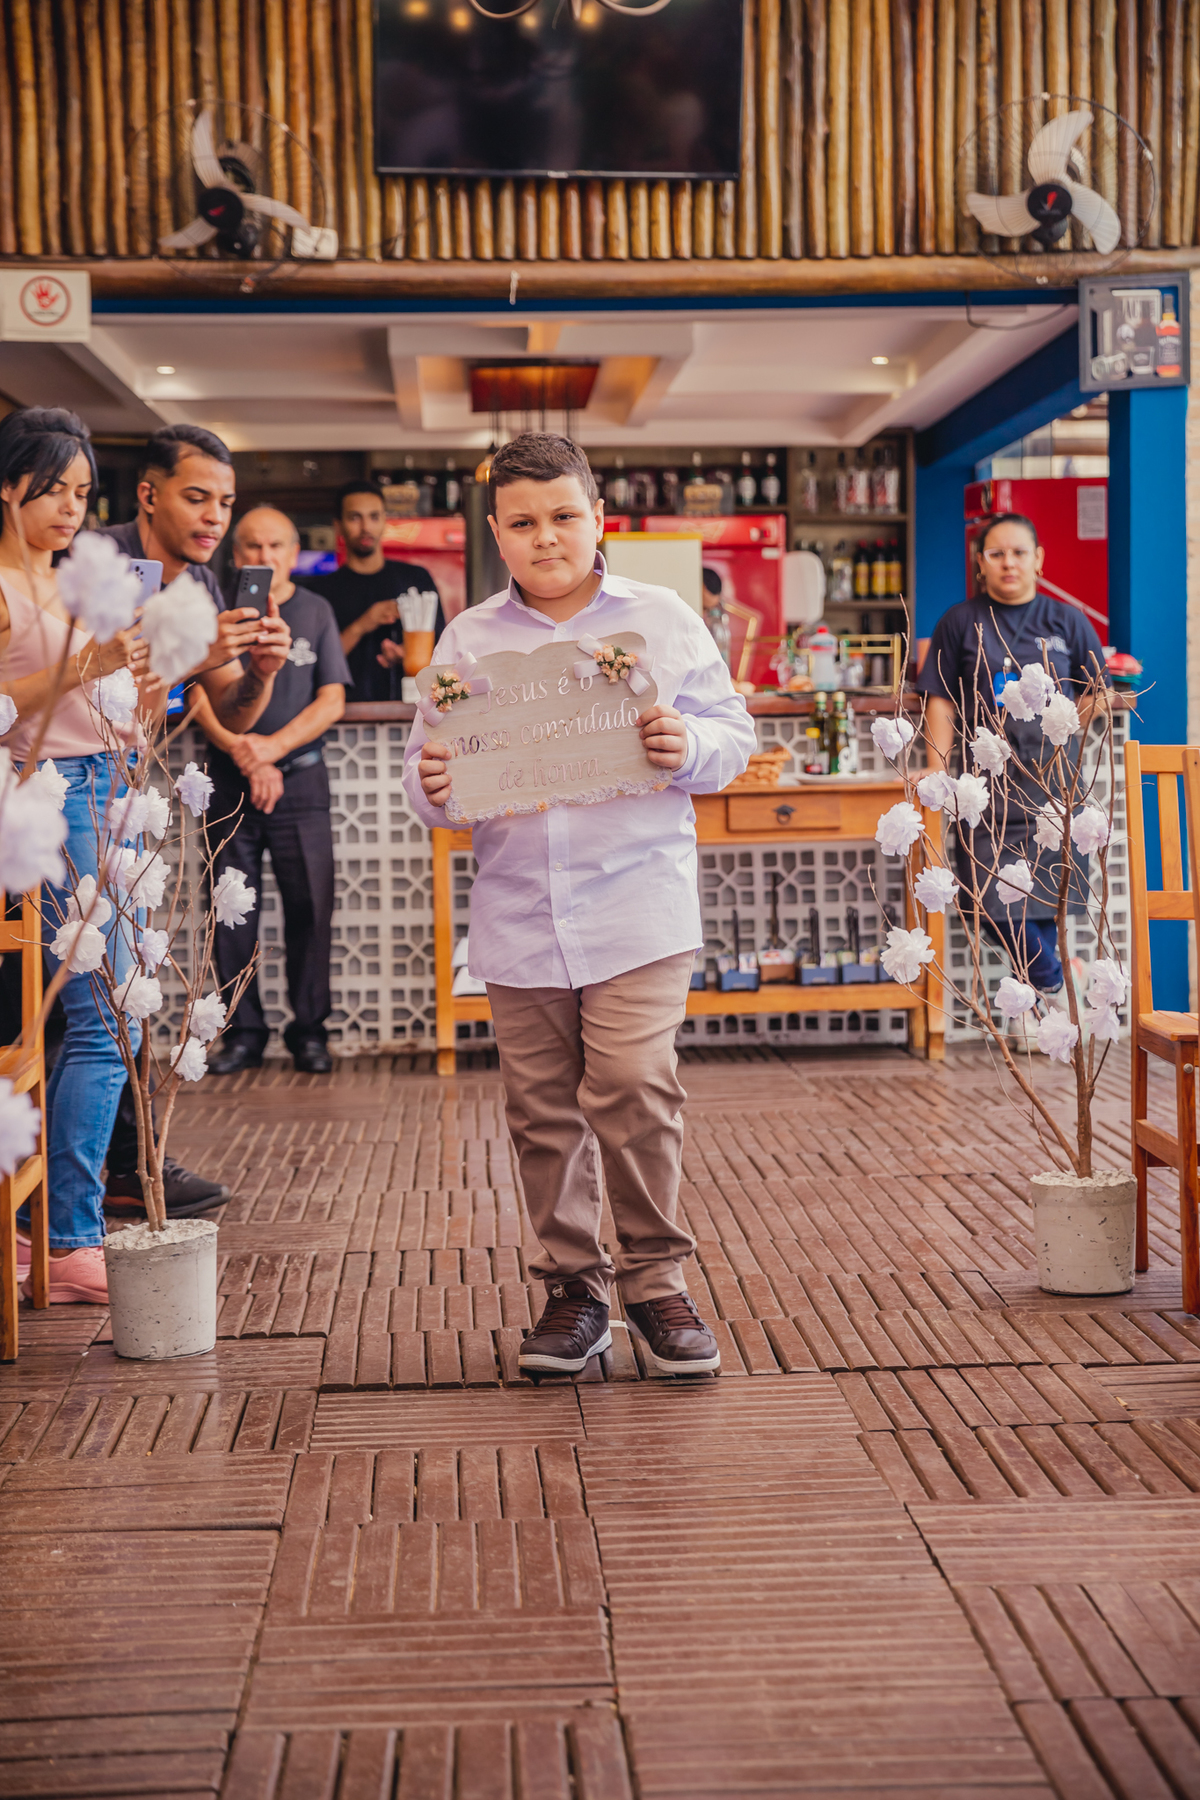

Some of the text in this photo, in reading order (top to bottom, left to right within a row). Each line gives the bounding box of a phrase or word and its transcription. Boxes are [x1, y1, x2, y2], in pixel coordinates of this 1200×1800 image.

[479, 668, 594, 715] Jesus é o
[450, 697, 640, 758] nosso convidado
[498, 757, 609, 791] de honra.
